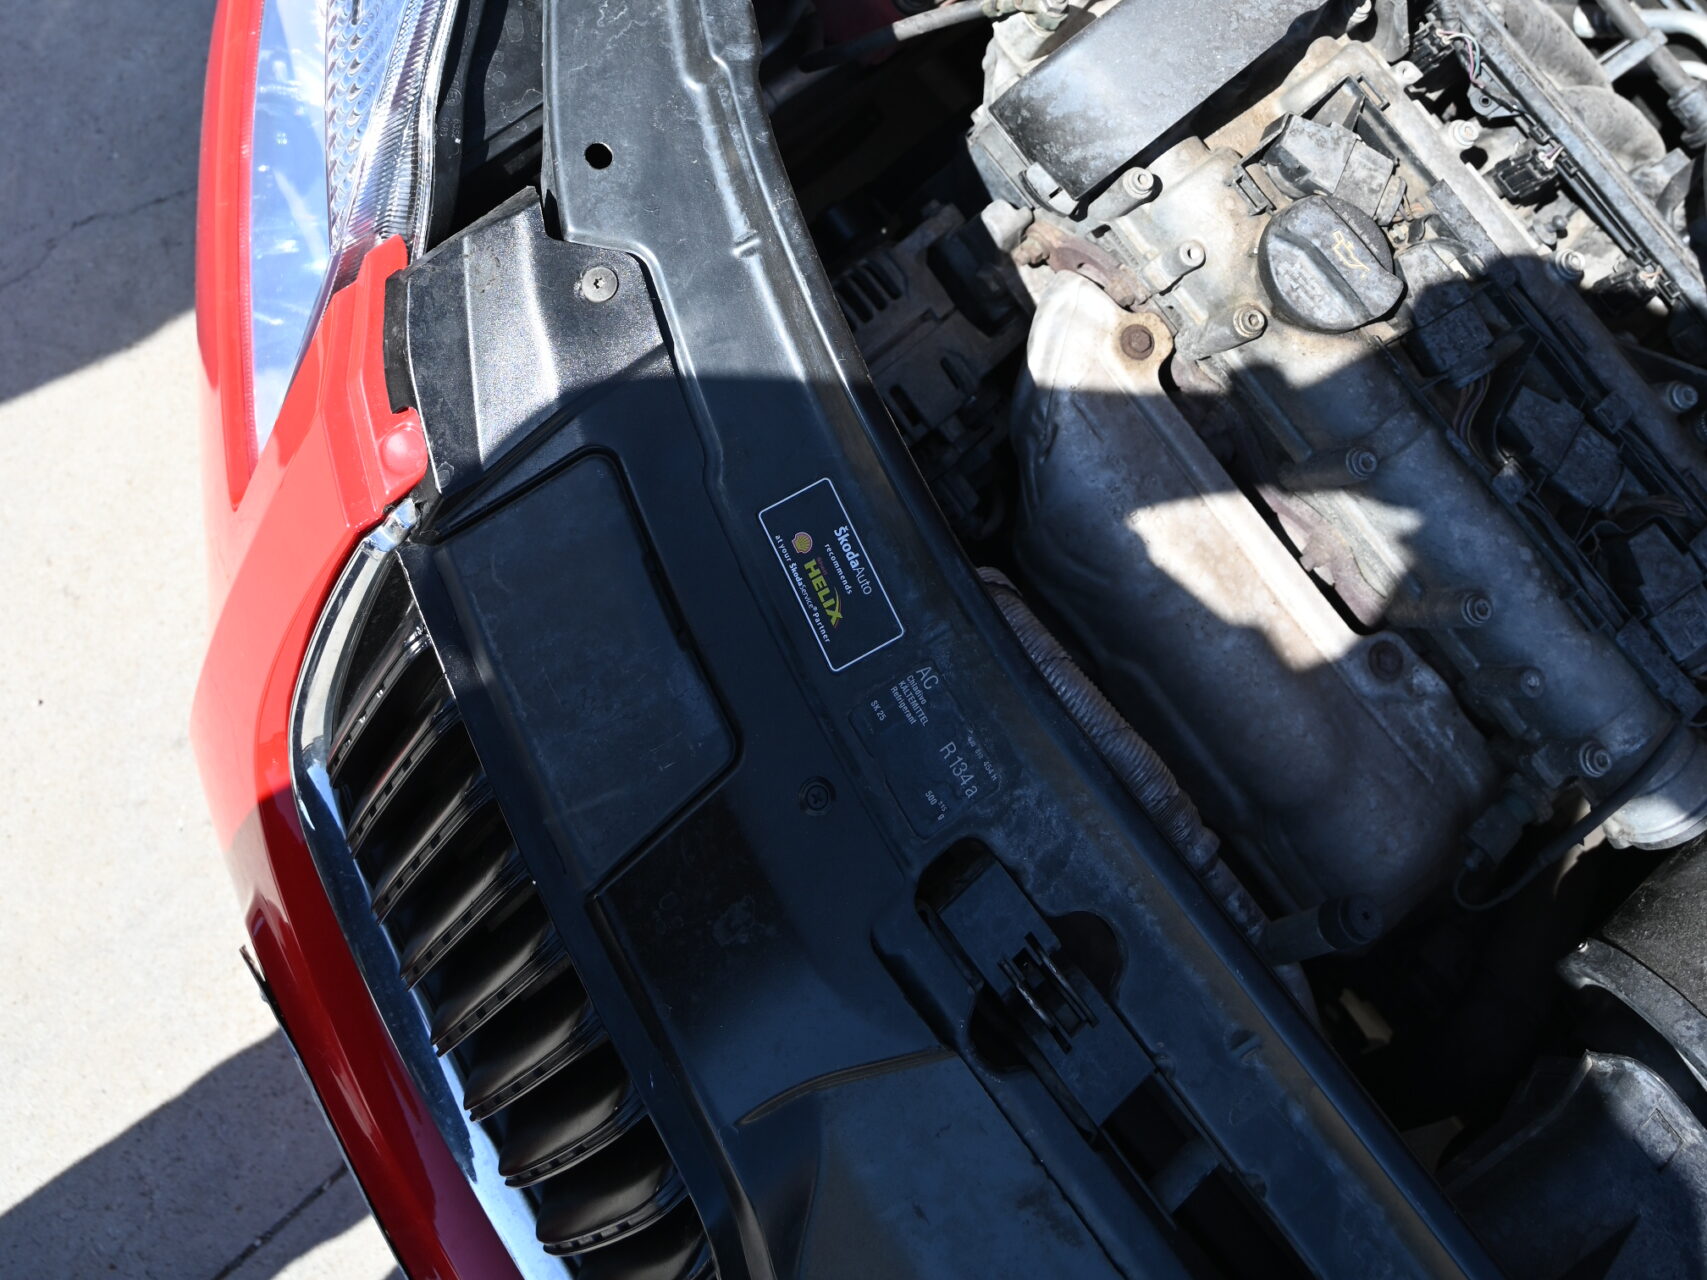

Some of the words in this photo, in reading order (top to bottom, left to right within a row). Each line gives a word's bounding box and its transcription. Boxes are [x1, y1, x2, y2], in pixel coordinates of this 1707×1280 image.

[774, 534, 783, 543] at
[778, 543, 791, 561] your
[825, 543, 852, 594] recommends
[834, 525, 871, 594] ŠkodaAuto
[803, 558, 843, 628] HELIX
[812, 611, 830, 642] Partner
[906, 674, 926, 704] Chladivo
[915, 666, 938, 689] AC
[870, 699, 881, 711] SK
[876, 709, 886, 720] 25
[890, 685, 917, 724] Refrigerant
[924, 790, 937, 805] 500
